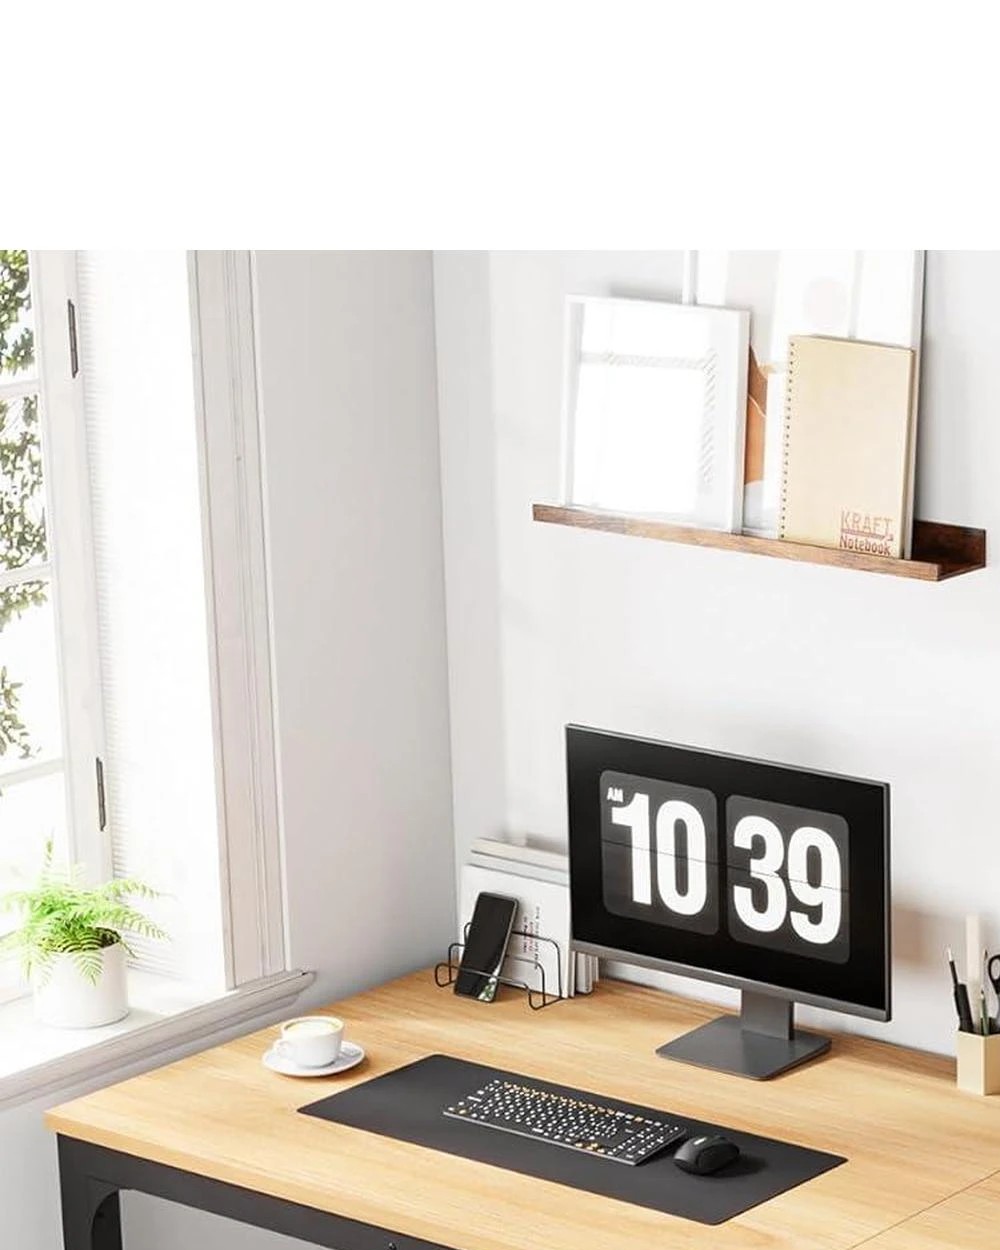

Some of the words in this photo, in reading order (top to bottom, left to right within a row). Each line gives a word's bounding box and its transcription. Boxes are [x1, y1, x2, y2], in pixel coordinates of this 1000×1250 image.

[841, 510, 893, 536] KRAFT
[840, 536, 891, 557] Notebook
[606, 787, 624, 802] AM
[611, 792, 707, 916] 10
[733, 815, 842, 944] 39
